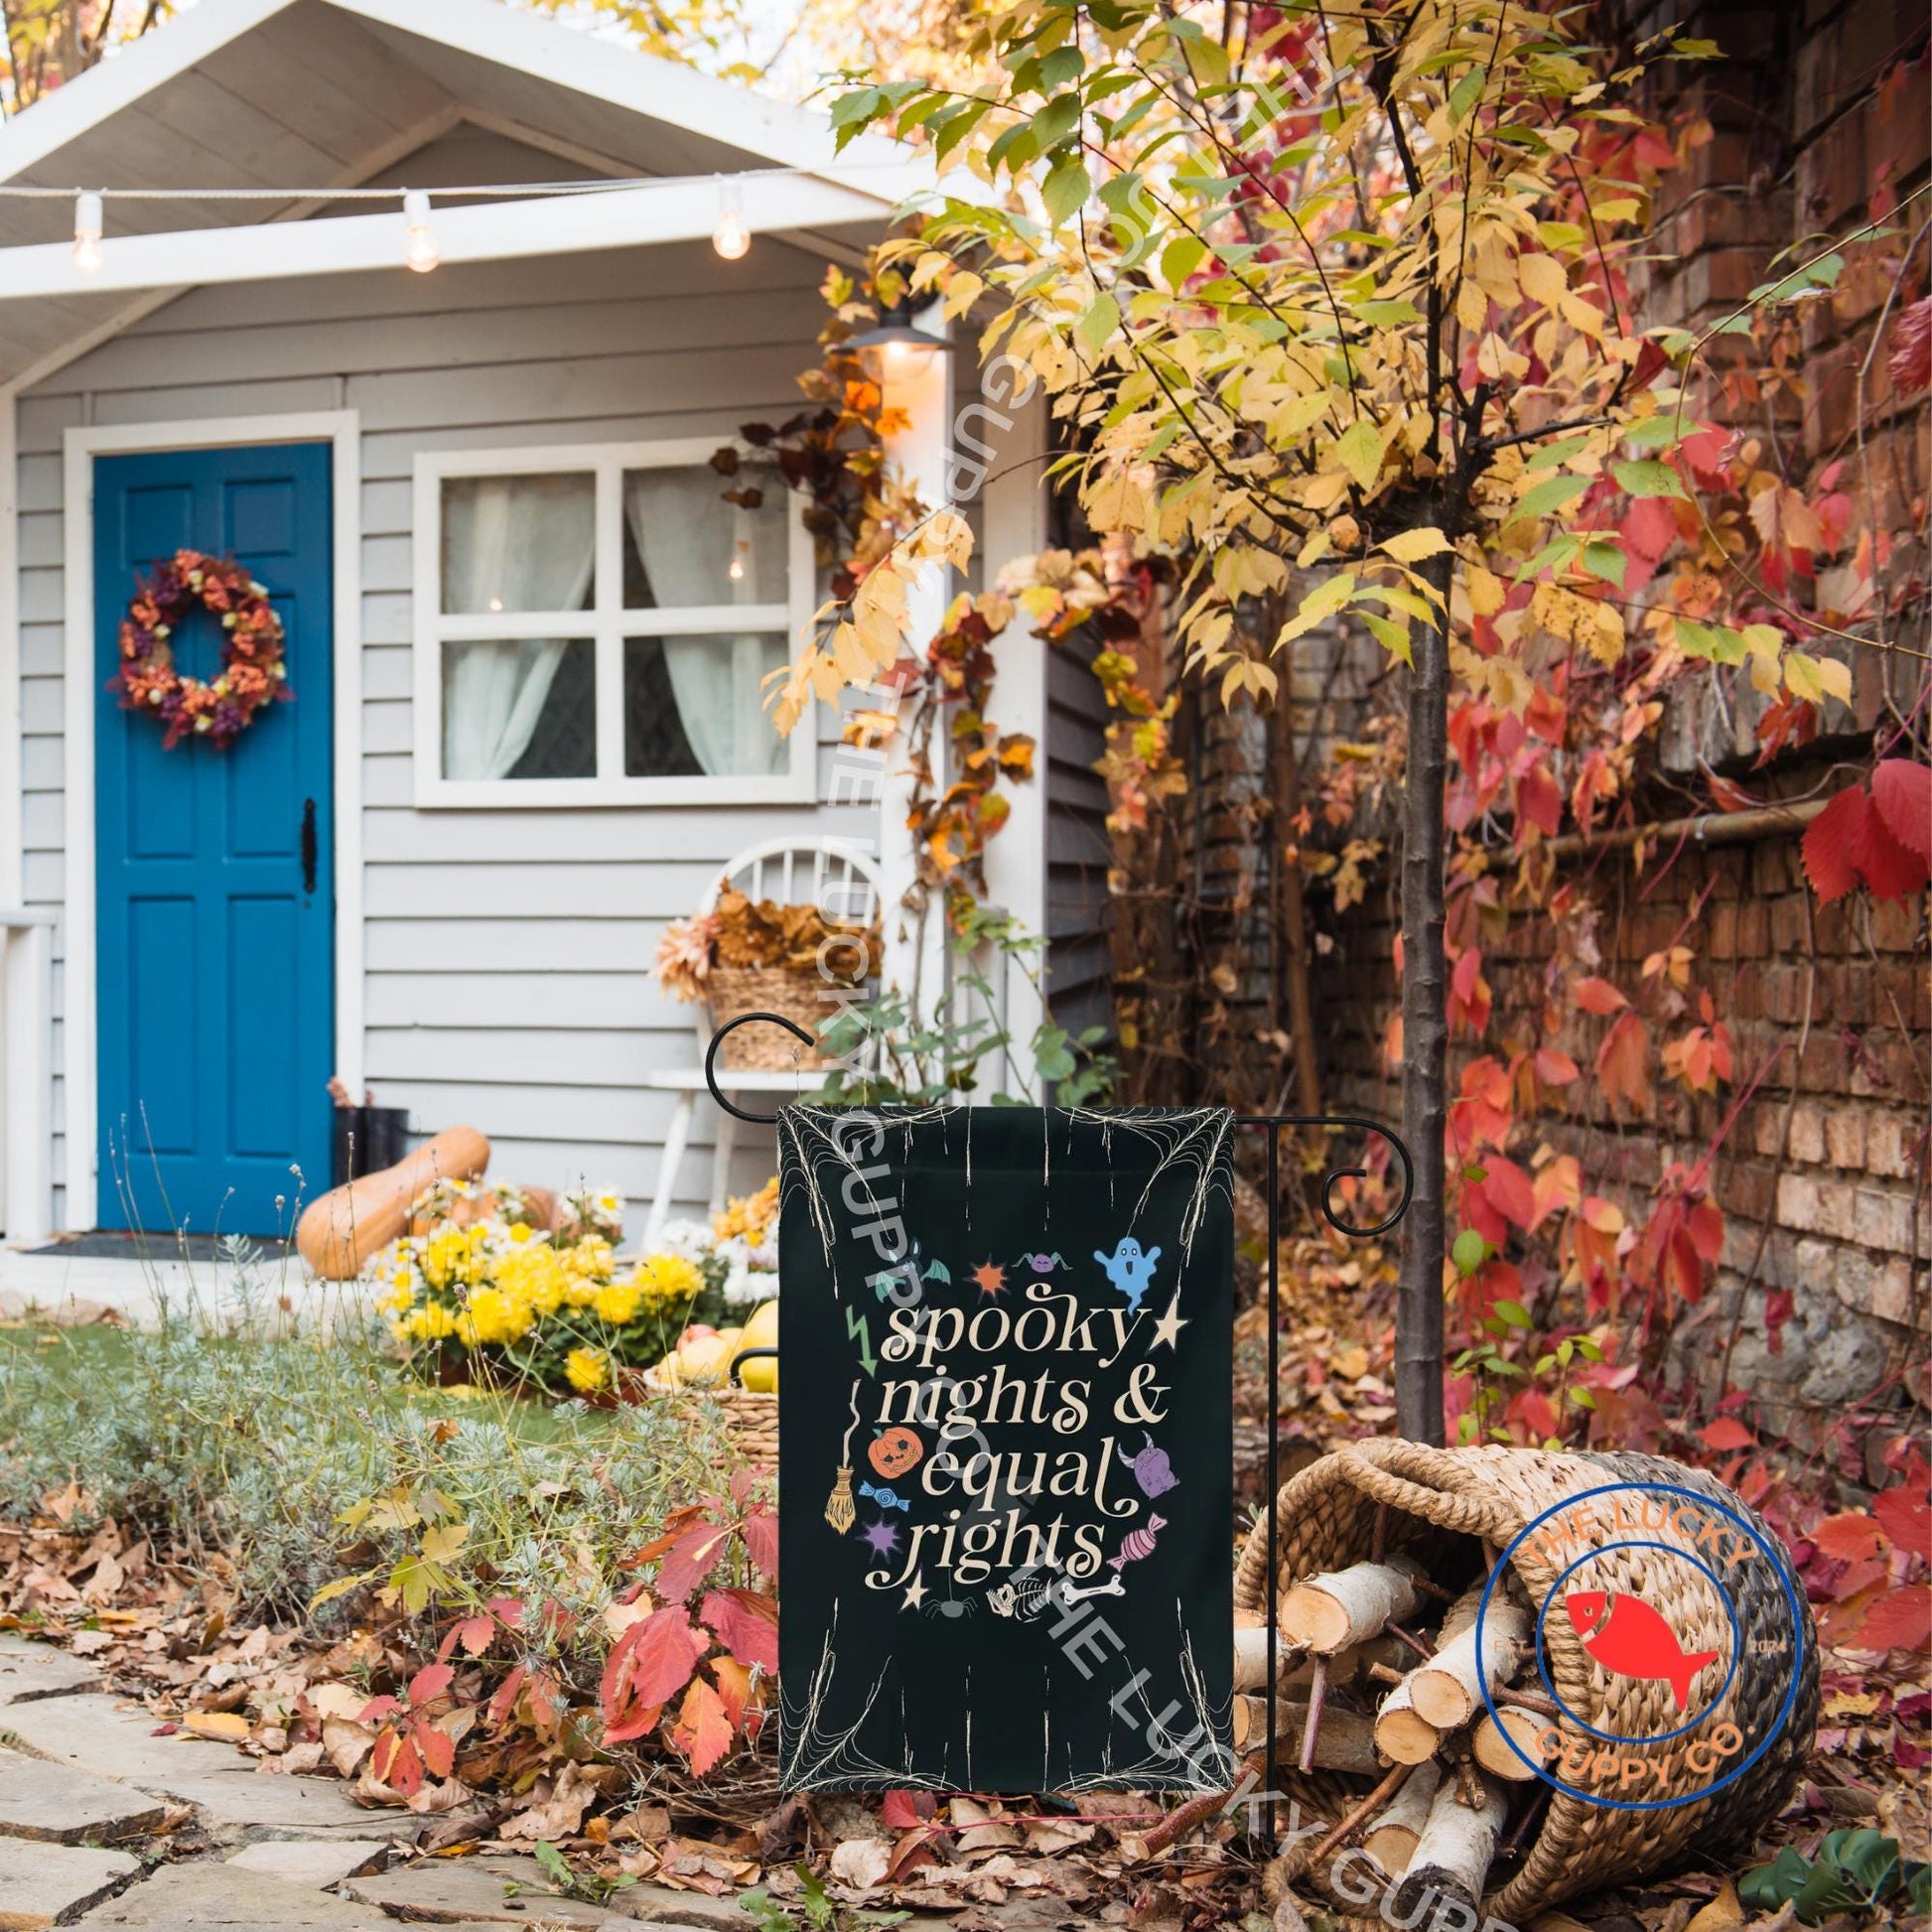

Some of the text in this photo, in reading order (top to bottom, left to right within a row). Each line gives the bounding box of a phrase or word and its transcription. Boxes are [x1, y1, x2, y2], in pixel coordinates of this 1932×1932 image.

[881, 1283, 1152, 1368] spooky
[875, 1363, 1171, 1441] nights &
[921, 1436, 1140, 1518] equal
[864, 1508, 1105, 1589] rights
